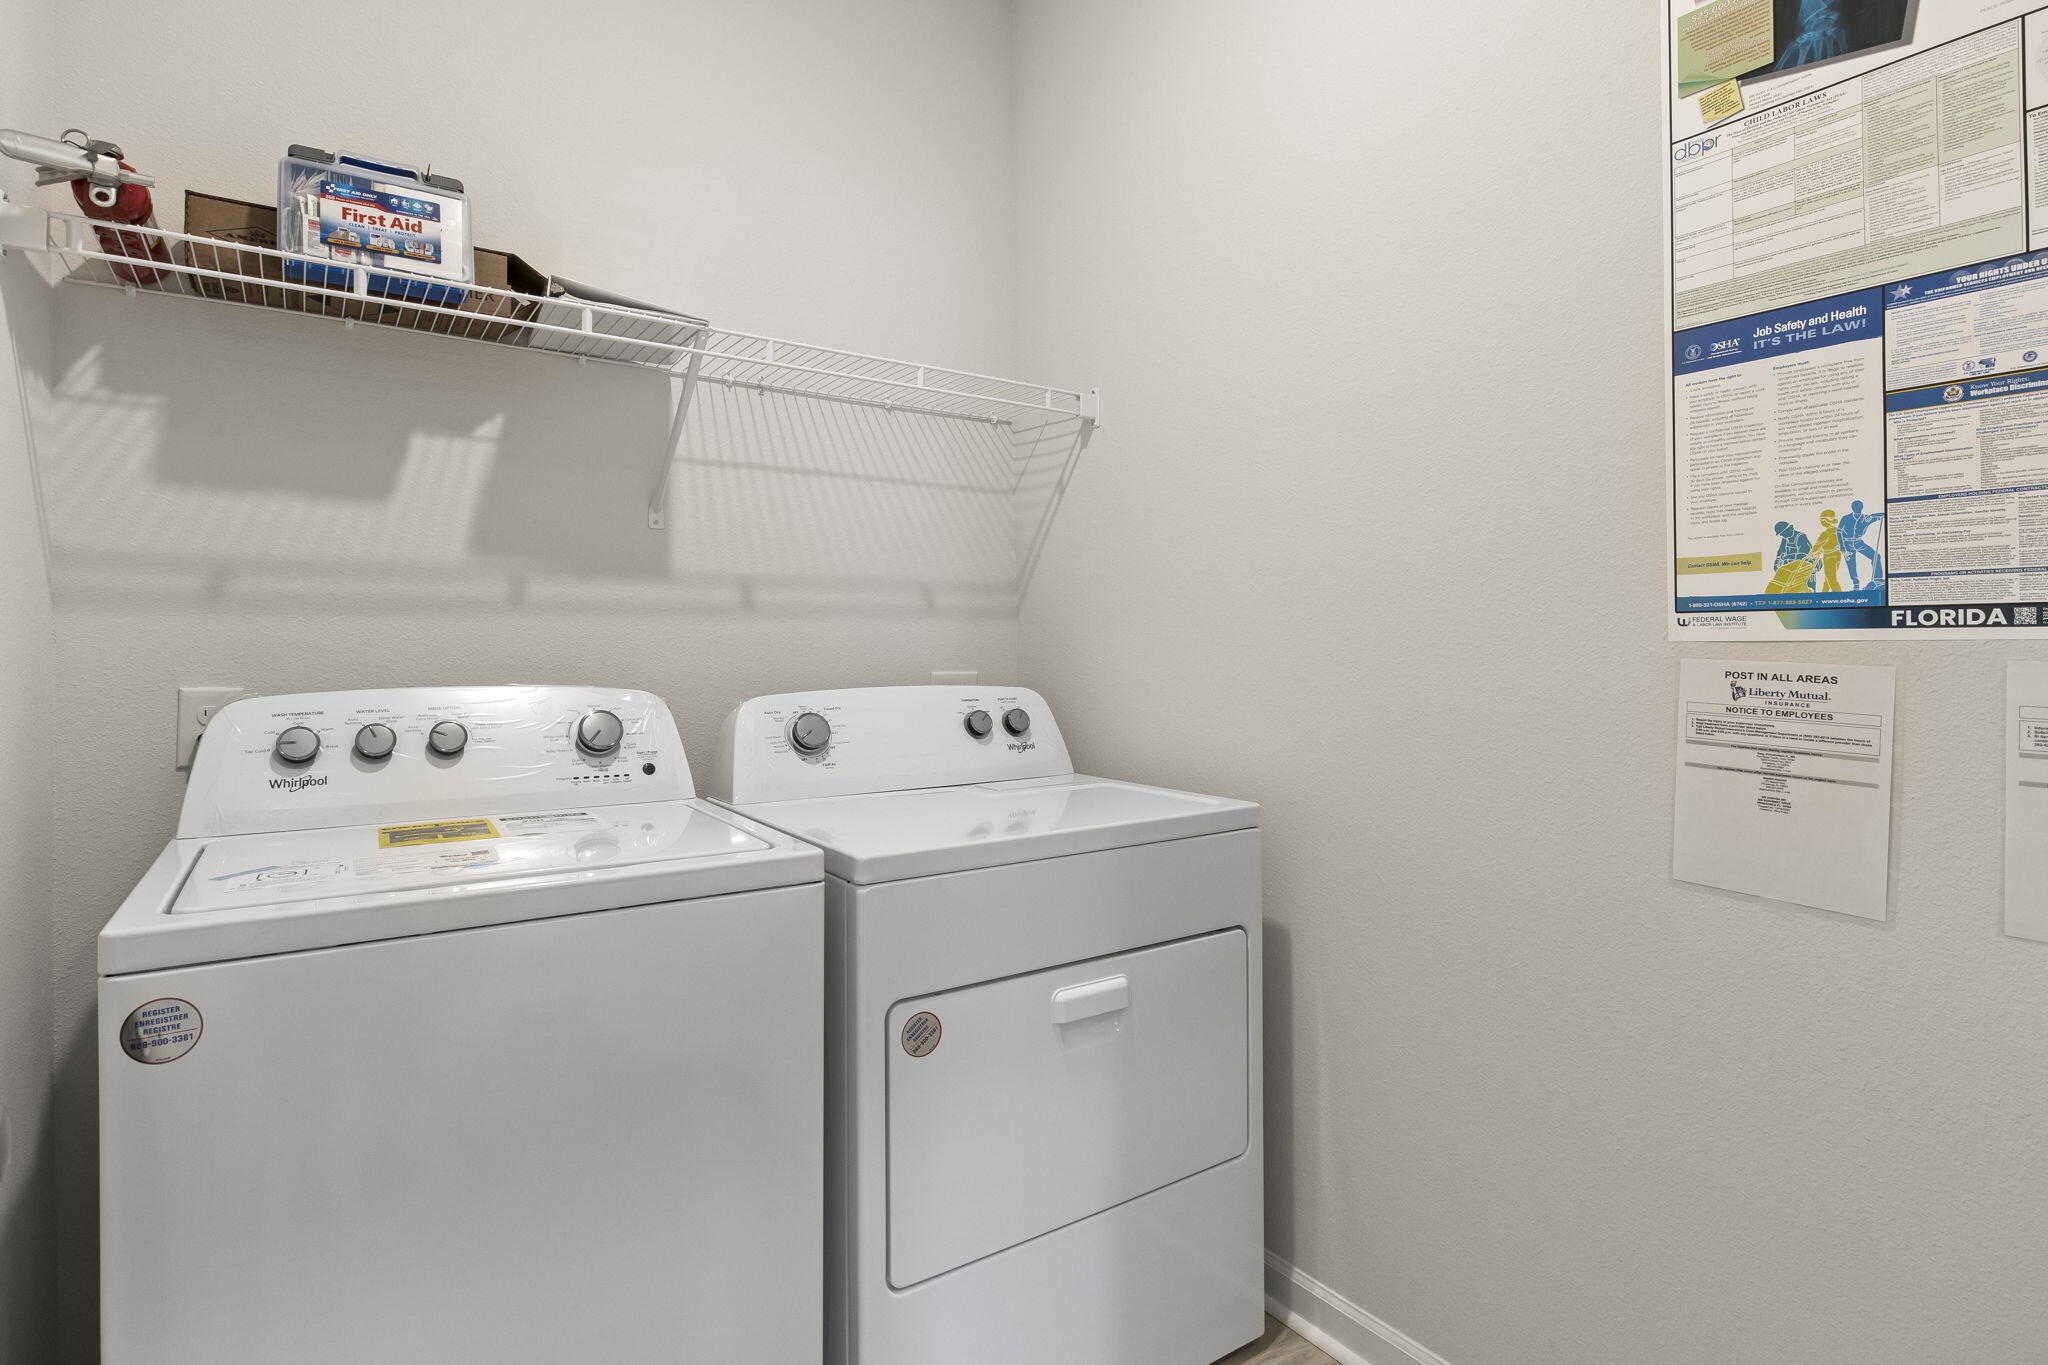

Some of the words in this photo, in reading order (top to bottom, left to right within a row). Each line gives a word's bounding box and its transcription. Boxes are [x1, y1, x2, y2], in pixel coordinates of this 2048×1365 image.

[1744, 112, 1770, 127] CHILD
[1772, 102, 1800, 117] LABOR
[1802, 92, 1828, 106] LAWS
[1674, 134, 1722, 160] dbpr
[334, 186, 350, 194] FIRST
[342, 206, 386, 228] First
[390, 216, 423, 234] Aid
[1956, 274, 1978, 284] YOUR
[1979, 266, 2010, 279] RIGHTS
[2010, 258, 2040, 272] UNDER
[1752, 324, 1773, 338] Job
[1774, 318, 1807, 334] Safety
[1808, 312, 1828, 326] and
[1830, 305, 1867, 322] Health
[1753, 336, 1781, 350] IT'S
[1785, 328, 1816, 342] THE
[1822, 318, 1867, 336] LAW!
[1710, 338, 1740, 351] OSHA
[1970, 386, 2008, 396] Workplace
[1891, 608, 2008, 626] FLORIDA
[1725, 671, 1754, 680] POST
[1756, 672, 1768, 681] IN
[1771, 674, 1793, 682] ALL
[1796, 675, 1838, 684] AREAS
[1749, 688, 1786, 701] Liberty
[1765, 700, 1811, 709] INSURANCE
[1725, 706, 1758, 715] NOTICE
[1775, 710, 1834, 721] EMPLOYEES
[1007, 742, 1036, 753] Whirlpool
[269, 775, 328, 792] Whirlpool
[142, 1006, 180, 1018] REGISTER
[134, 1013, 189, 1028] ENREGISTRER
[143, 1023, 181, 1036] REGISTRE
